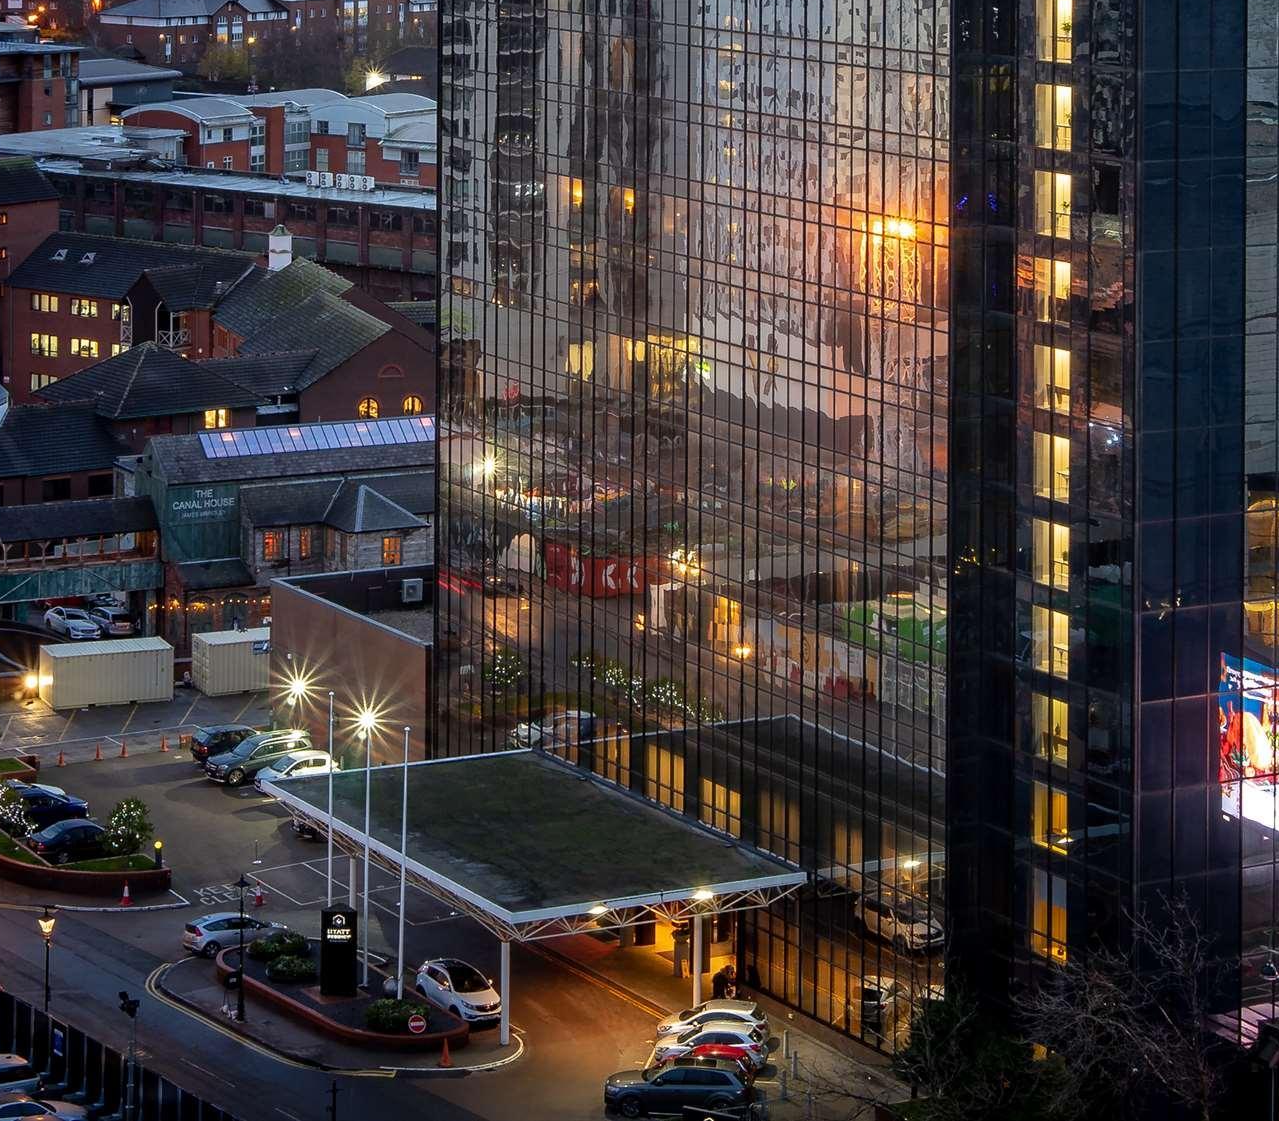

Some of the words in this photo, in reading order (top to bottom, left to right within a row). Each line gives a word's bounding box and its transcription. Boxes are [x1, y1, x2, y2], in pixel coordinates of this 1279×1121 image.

[195, 488, 214, 498] THE
[172, 499, 202, 510] CANAL
[203, 497, 236, 508] HOUSE
